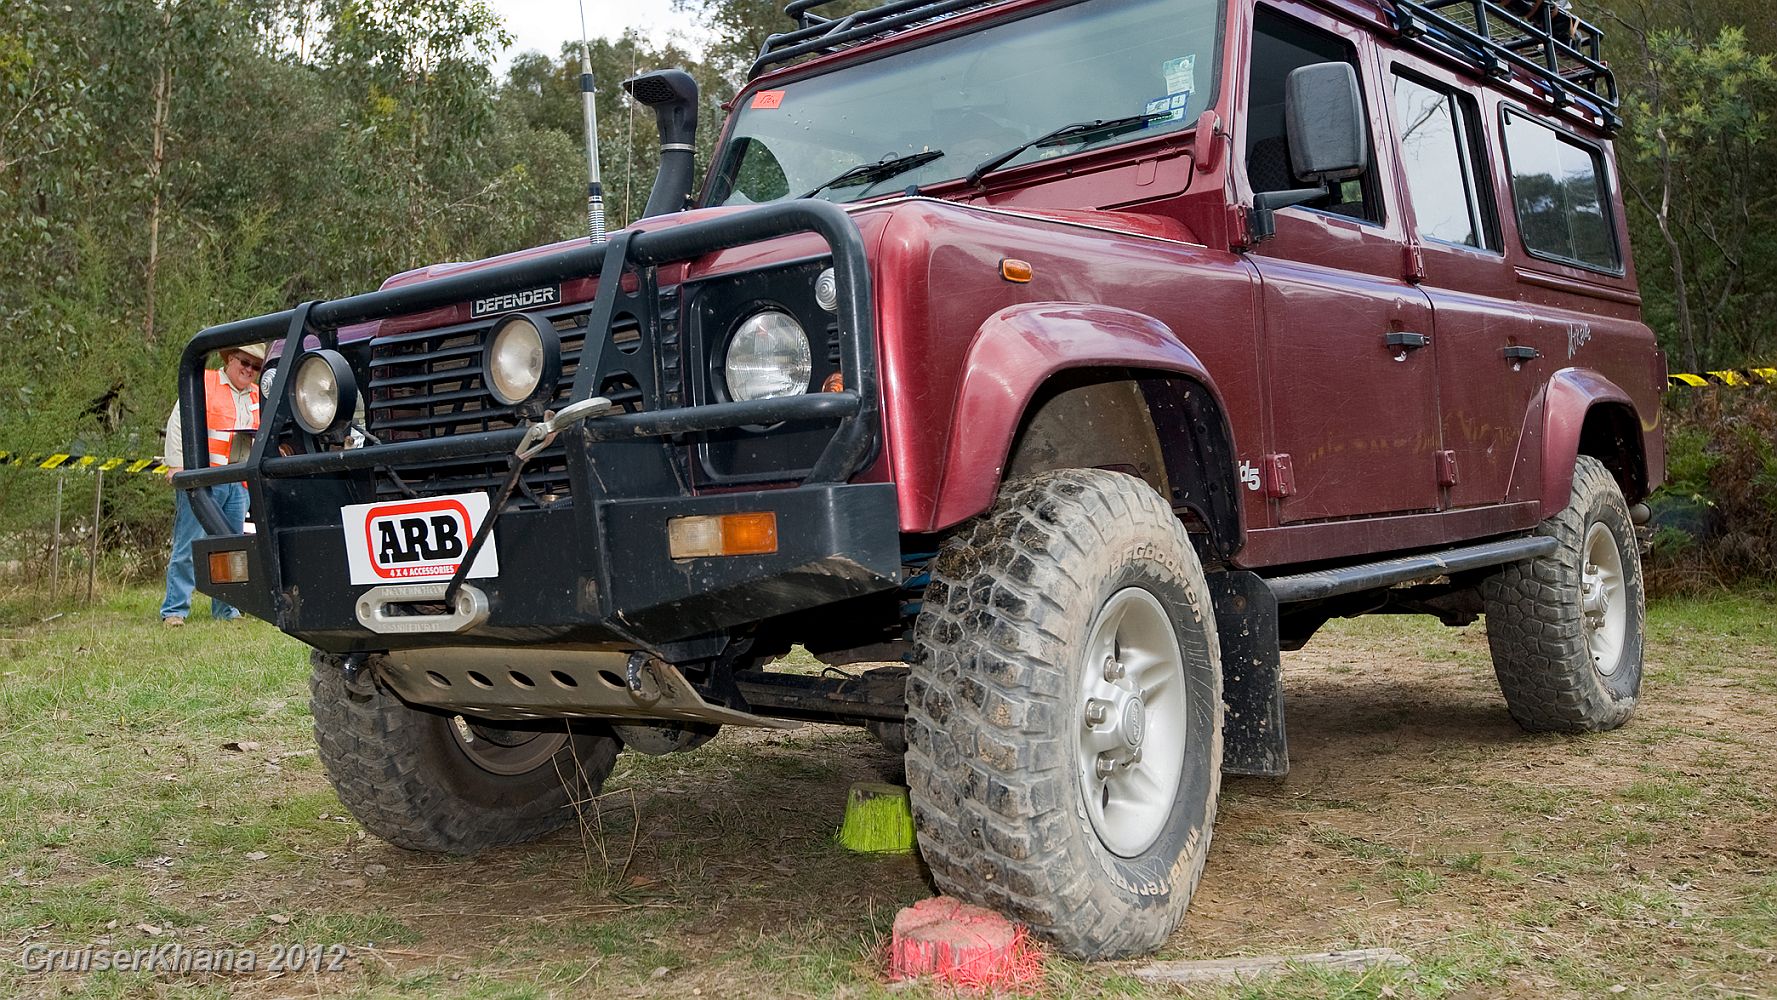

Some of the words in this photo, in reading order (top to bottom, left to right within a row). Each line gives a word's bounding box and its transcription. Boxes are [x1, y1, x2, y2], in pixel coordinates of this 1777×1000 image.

[476, 287, 554, 313] DEFENDER
[377, 515, 463, 563] ARB
[409, 565, 455, 576] ACCESSORIES
